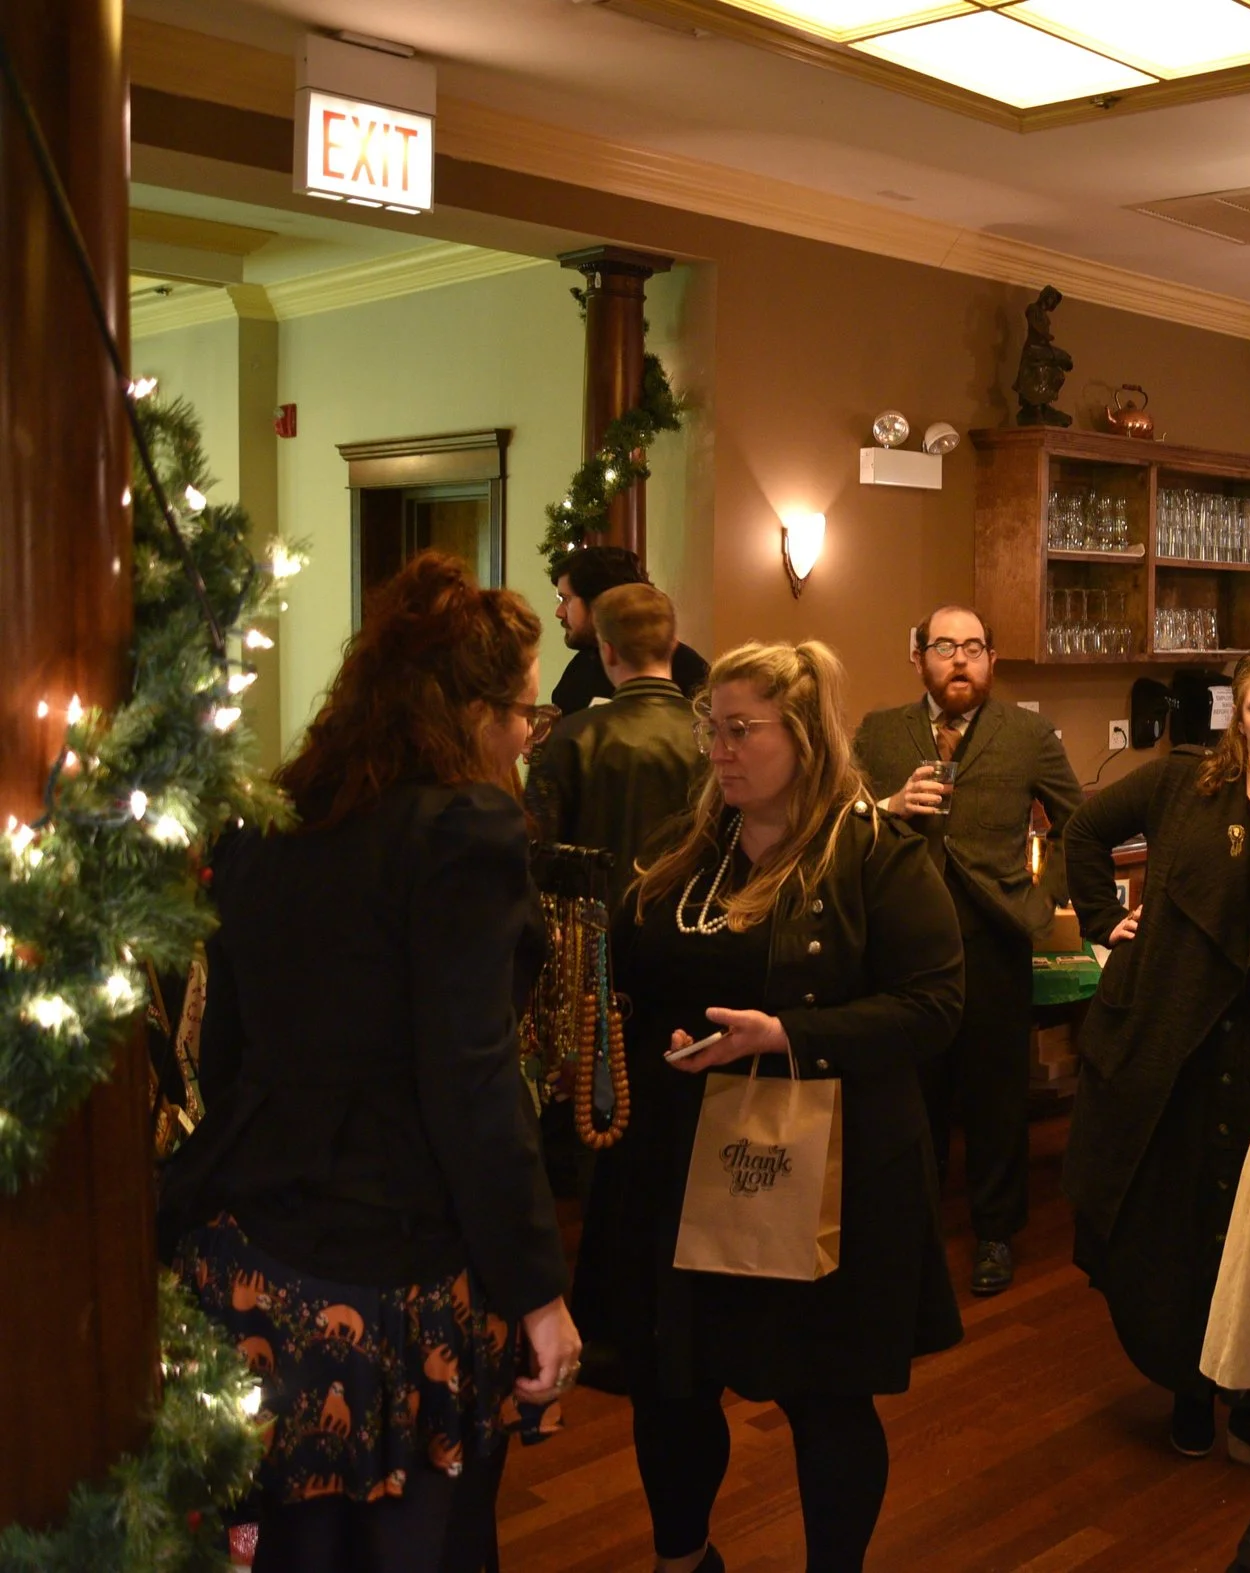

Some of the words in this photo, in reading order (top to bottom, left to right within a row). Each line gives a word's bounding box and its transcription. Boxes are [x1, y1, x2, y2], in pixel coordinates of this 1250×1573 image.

[322, 109, 418, 191] EXIT
[719, 1138, 792, 1176] Thank
[730, 1170, 778, 1197] you
